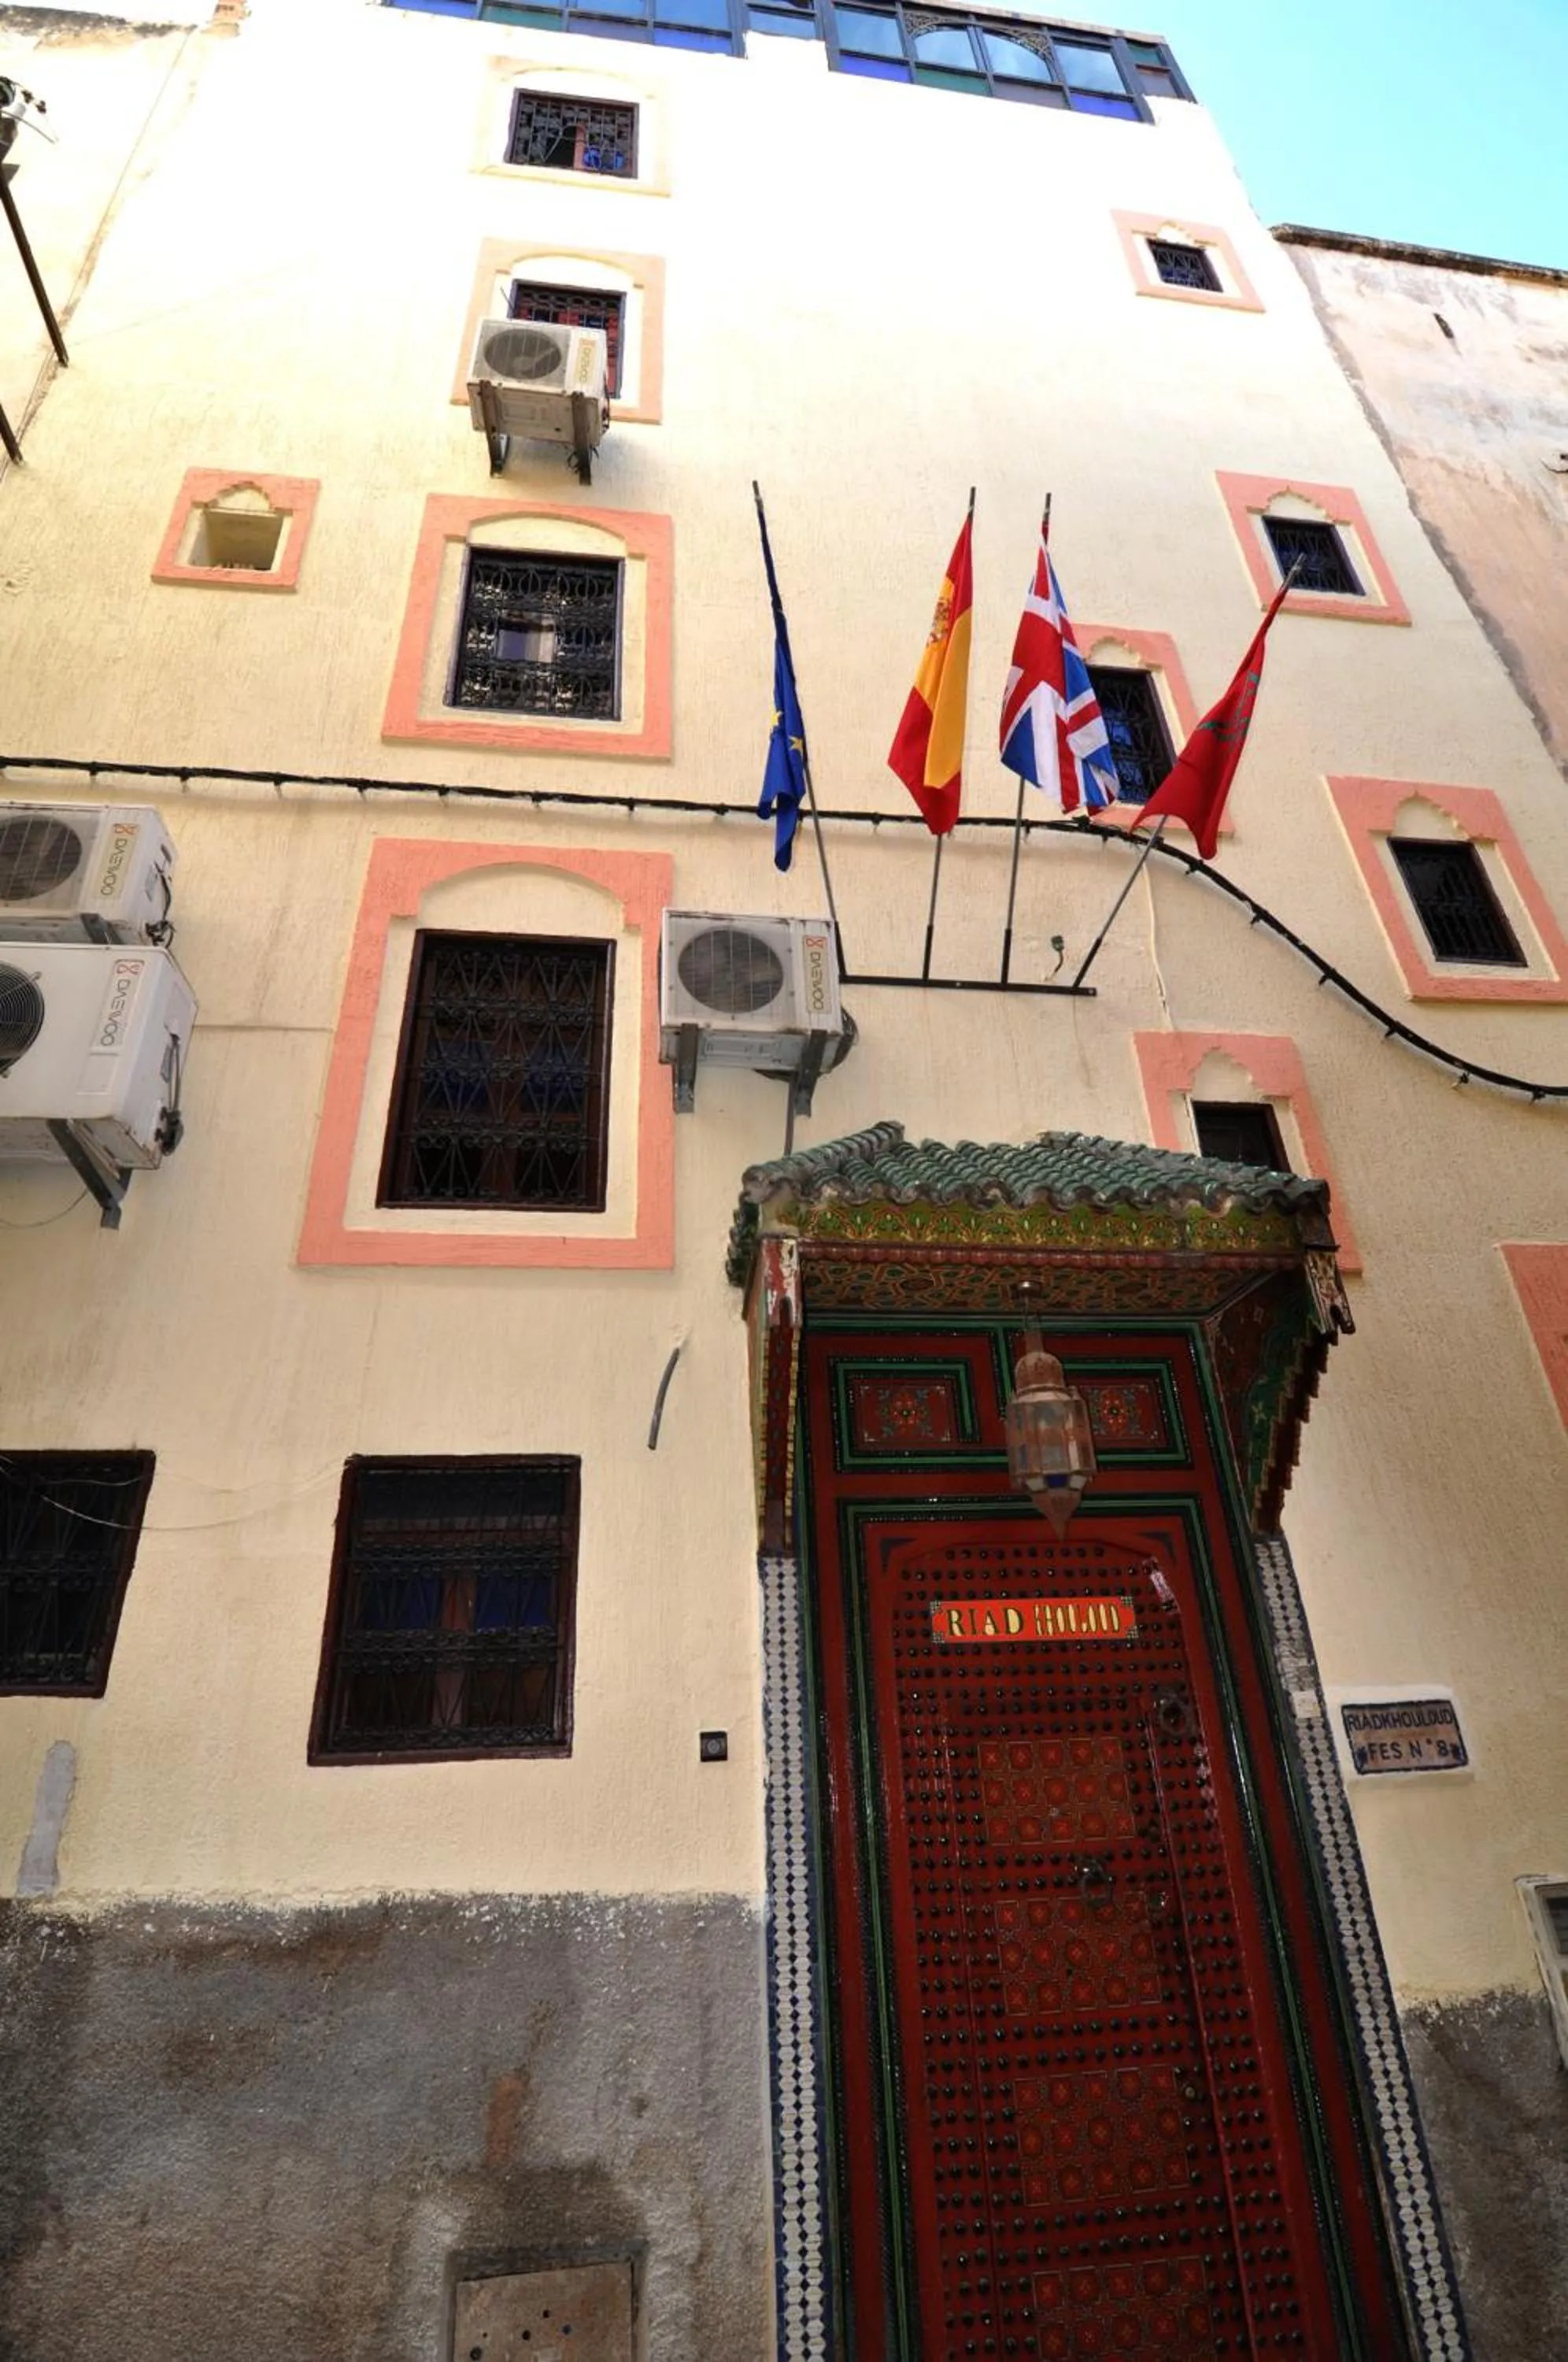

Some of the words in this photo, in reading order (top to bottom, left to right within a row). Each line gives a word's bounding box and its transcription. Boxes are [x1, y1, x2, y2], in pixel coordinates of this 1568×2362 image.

[101, 838, 128, 896] DAEWOO
[810, 951, 824, 1009] DAEWOO
[101, 979, 131, 1046] DAEWOO
[946, 1608, 1023, 1636] RIAD
[1367, 1742, 1403, 1761] FES
